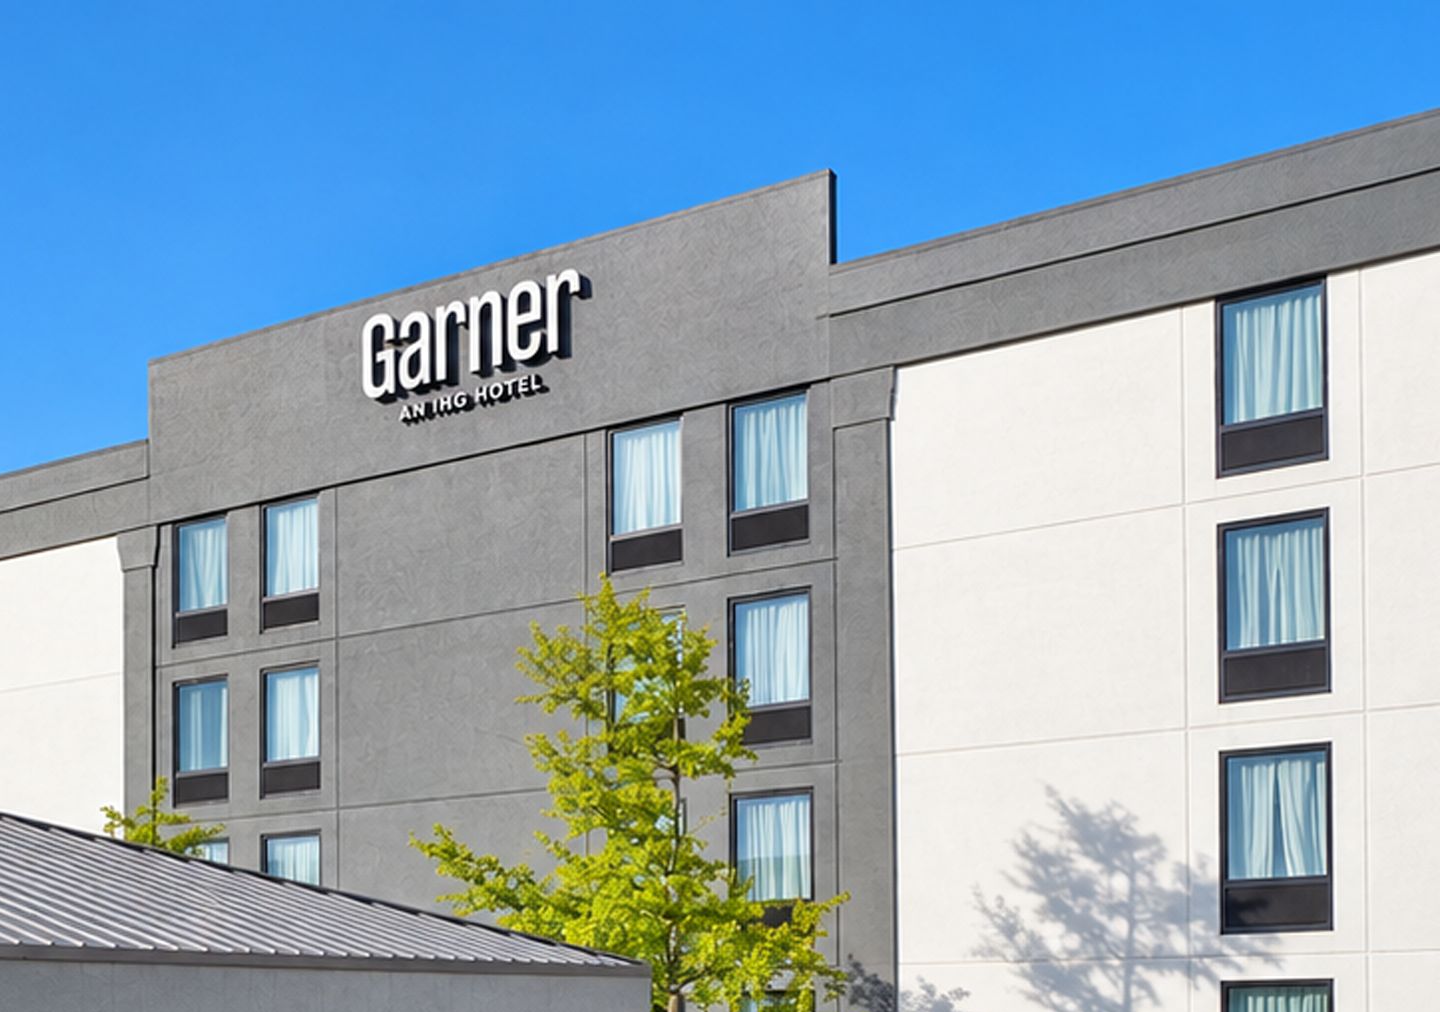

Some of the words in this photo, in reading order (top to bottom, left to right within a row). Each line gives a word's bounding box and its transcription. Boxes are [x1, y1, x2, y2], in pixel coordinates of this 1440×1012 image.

[362, 268, 581, 398] Garner
[399, 404, 426, 421] AN
[432, 391, 468, 413] IHG
[474, 374, 542, 403] HOTEL
